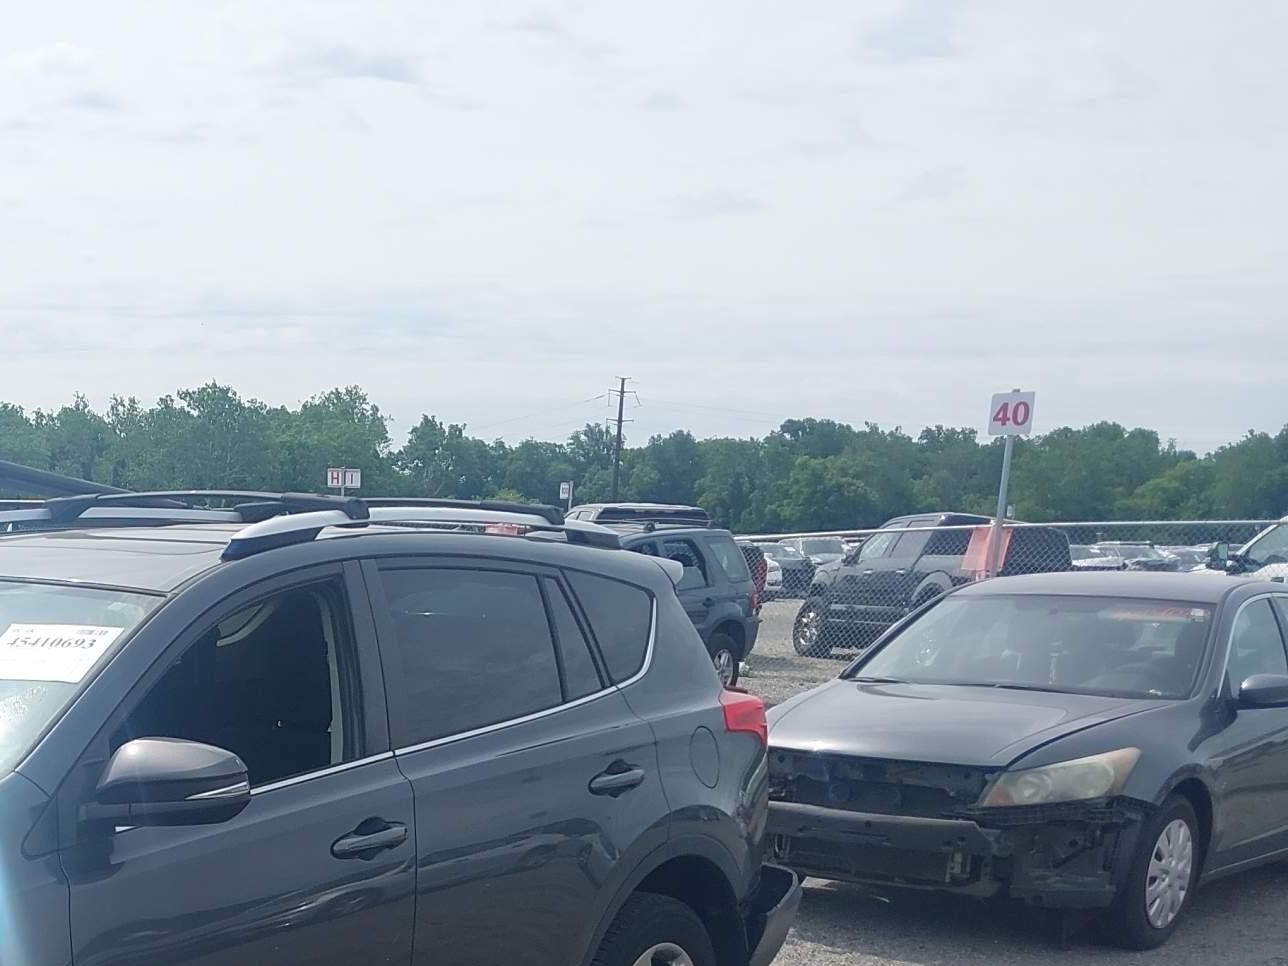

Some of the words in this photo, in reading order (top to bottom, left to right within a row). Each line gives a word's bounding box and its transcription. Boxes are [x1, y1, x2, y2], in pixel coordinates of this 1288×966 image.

[993, 401, 1030, 426] 40
[330, 471, 340, 485] H
[7, 636, 97, 649] 45410693
